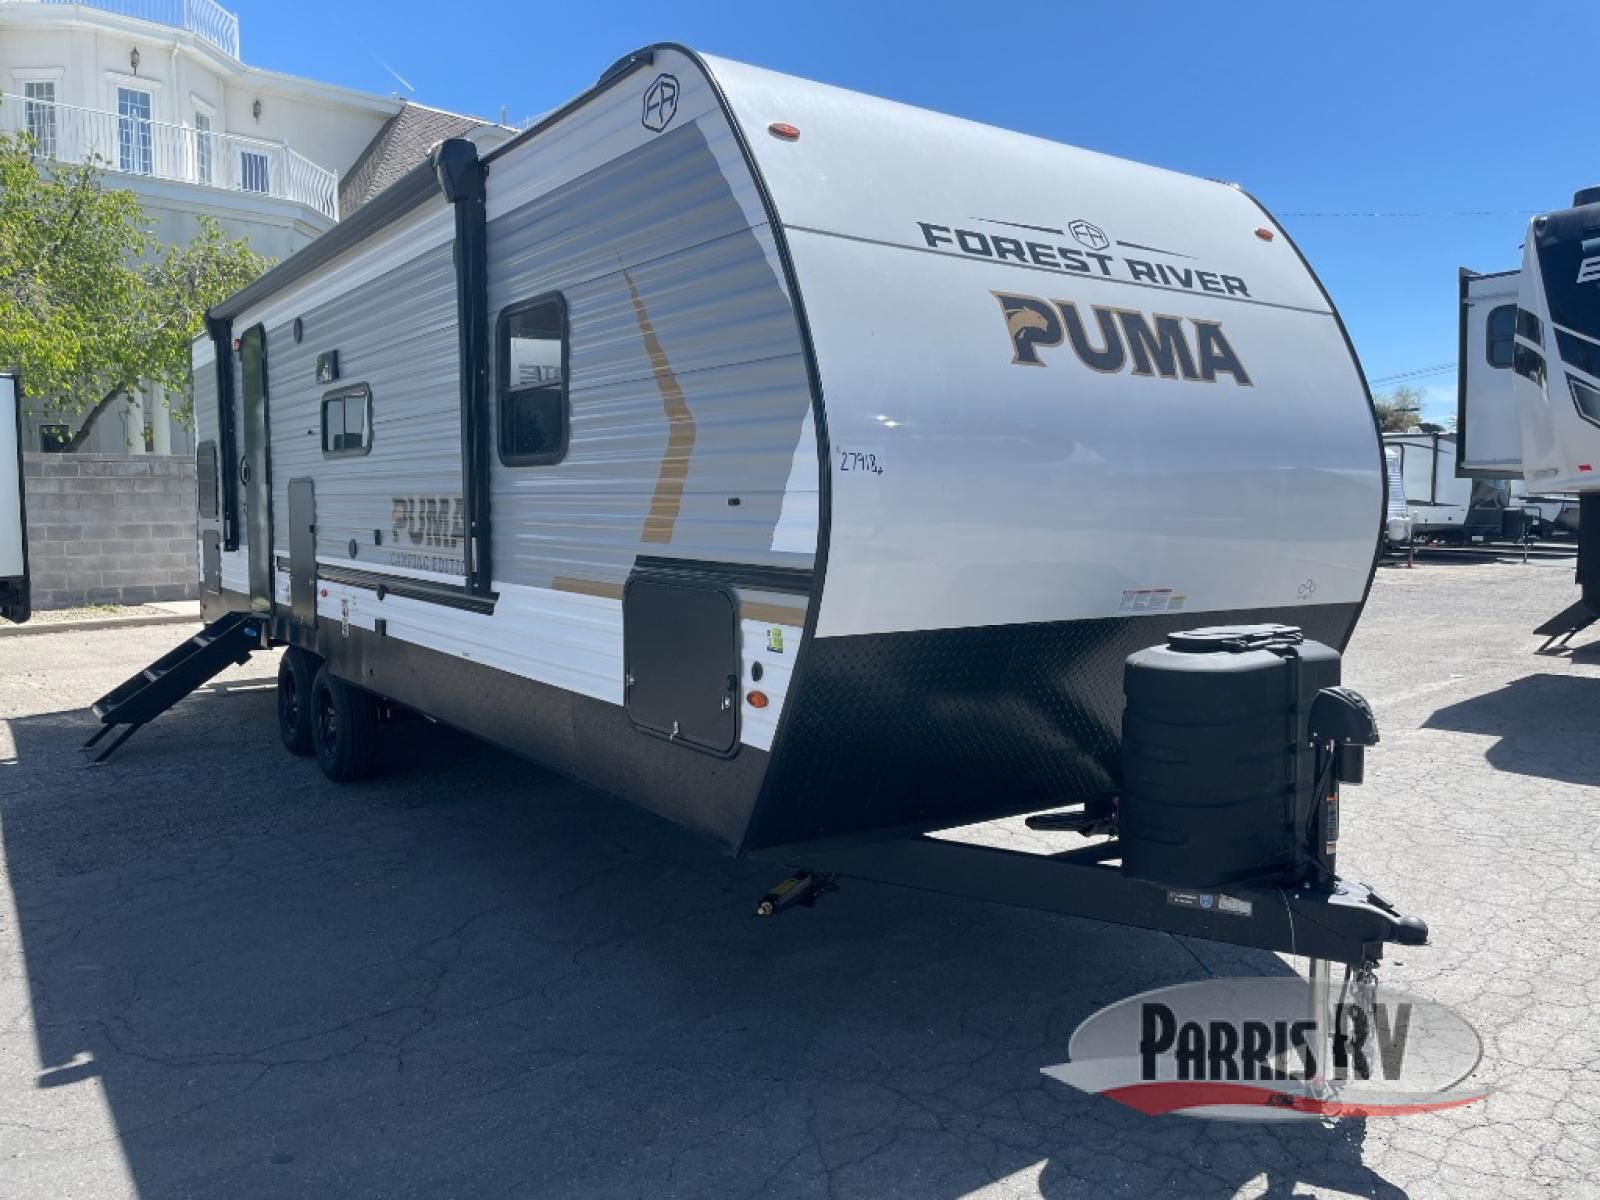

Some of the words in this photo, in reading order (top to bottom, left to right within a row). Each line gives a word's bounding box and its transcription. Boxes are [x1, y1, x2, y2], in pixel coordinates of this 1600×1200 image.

[916, 221, 1114, 277] FOREST
[1122, 257, 1252, 298] RIVER
[988, 289, 1254, 388] PUMA
